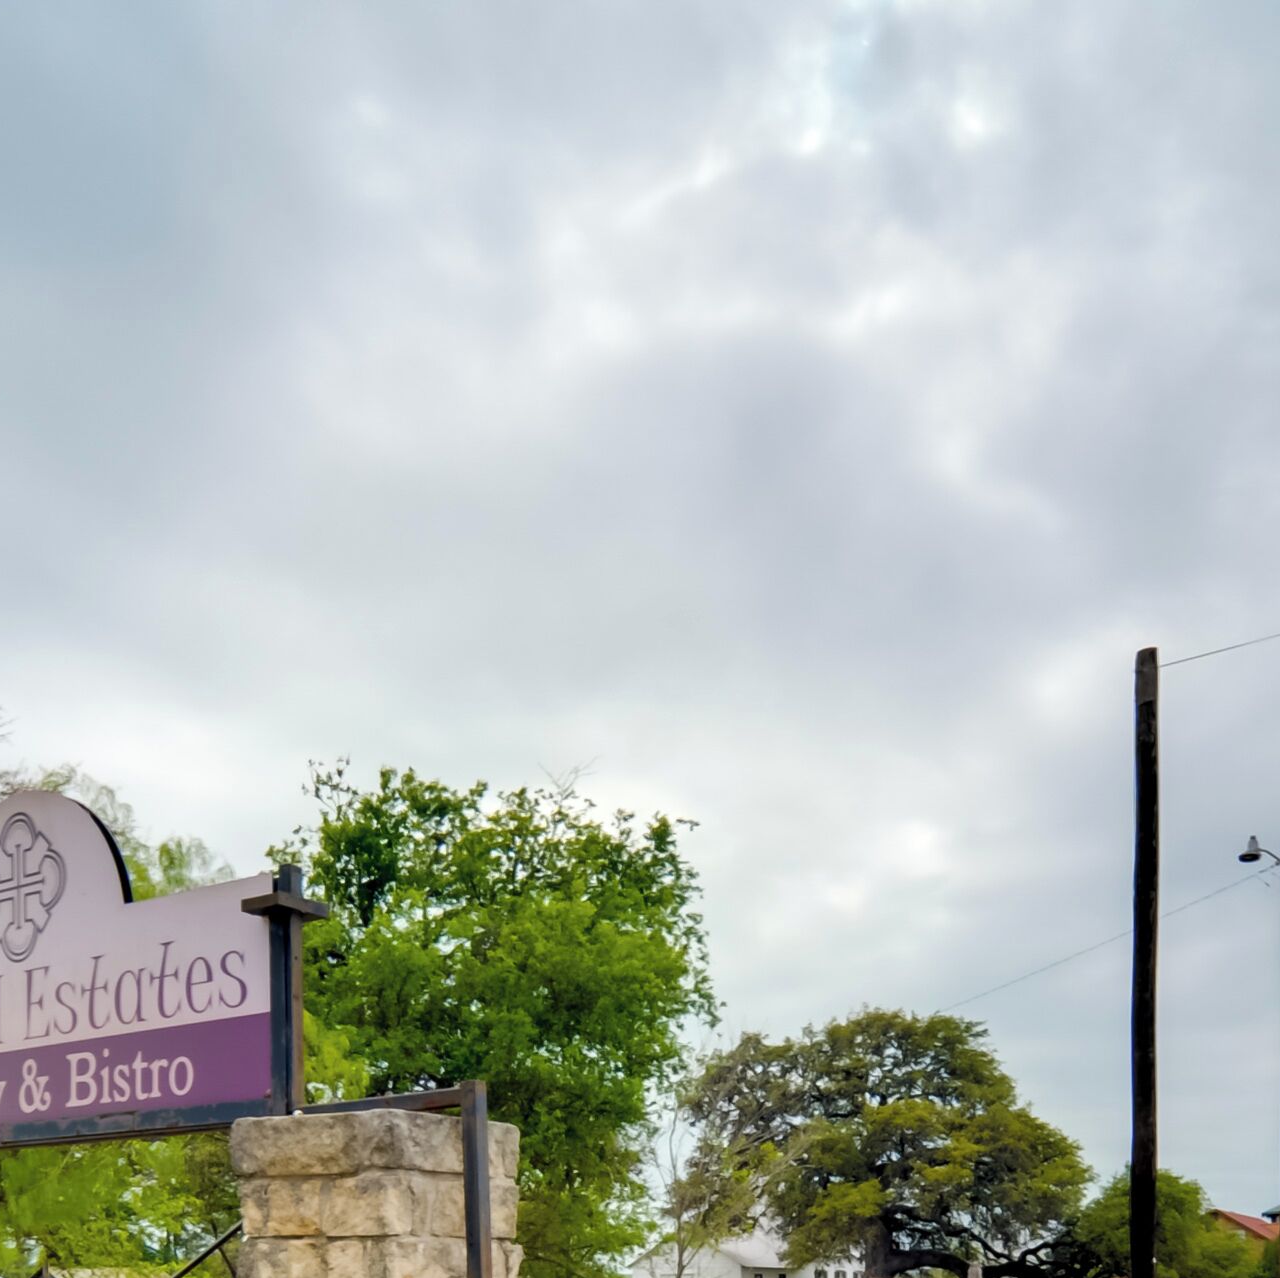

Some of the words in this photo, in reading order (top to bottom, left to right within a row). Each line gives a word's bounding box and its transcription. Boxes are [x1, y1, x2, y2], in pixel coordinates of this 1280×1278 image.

[23, 940, 248, 1040] Estates
[18, 1058, 52, 1113] &
[65, 1048, 194, 1108] Bistro
